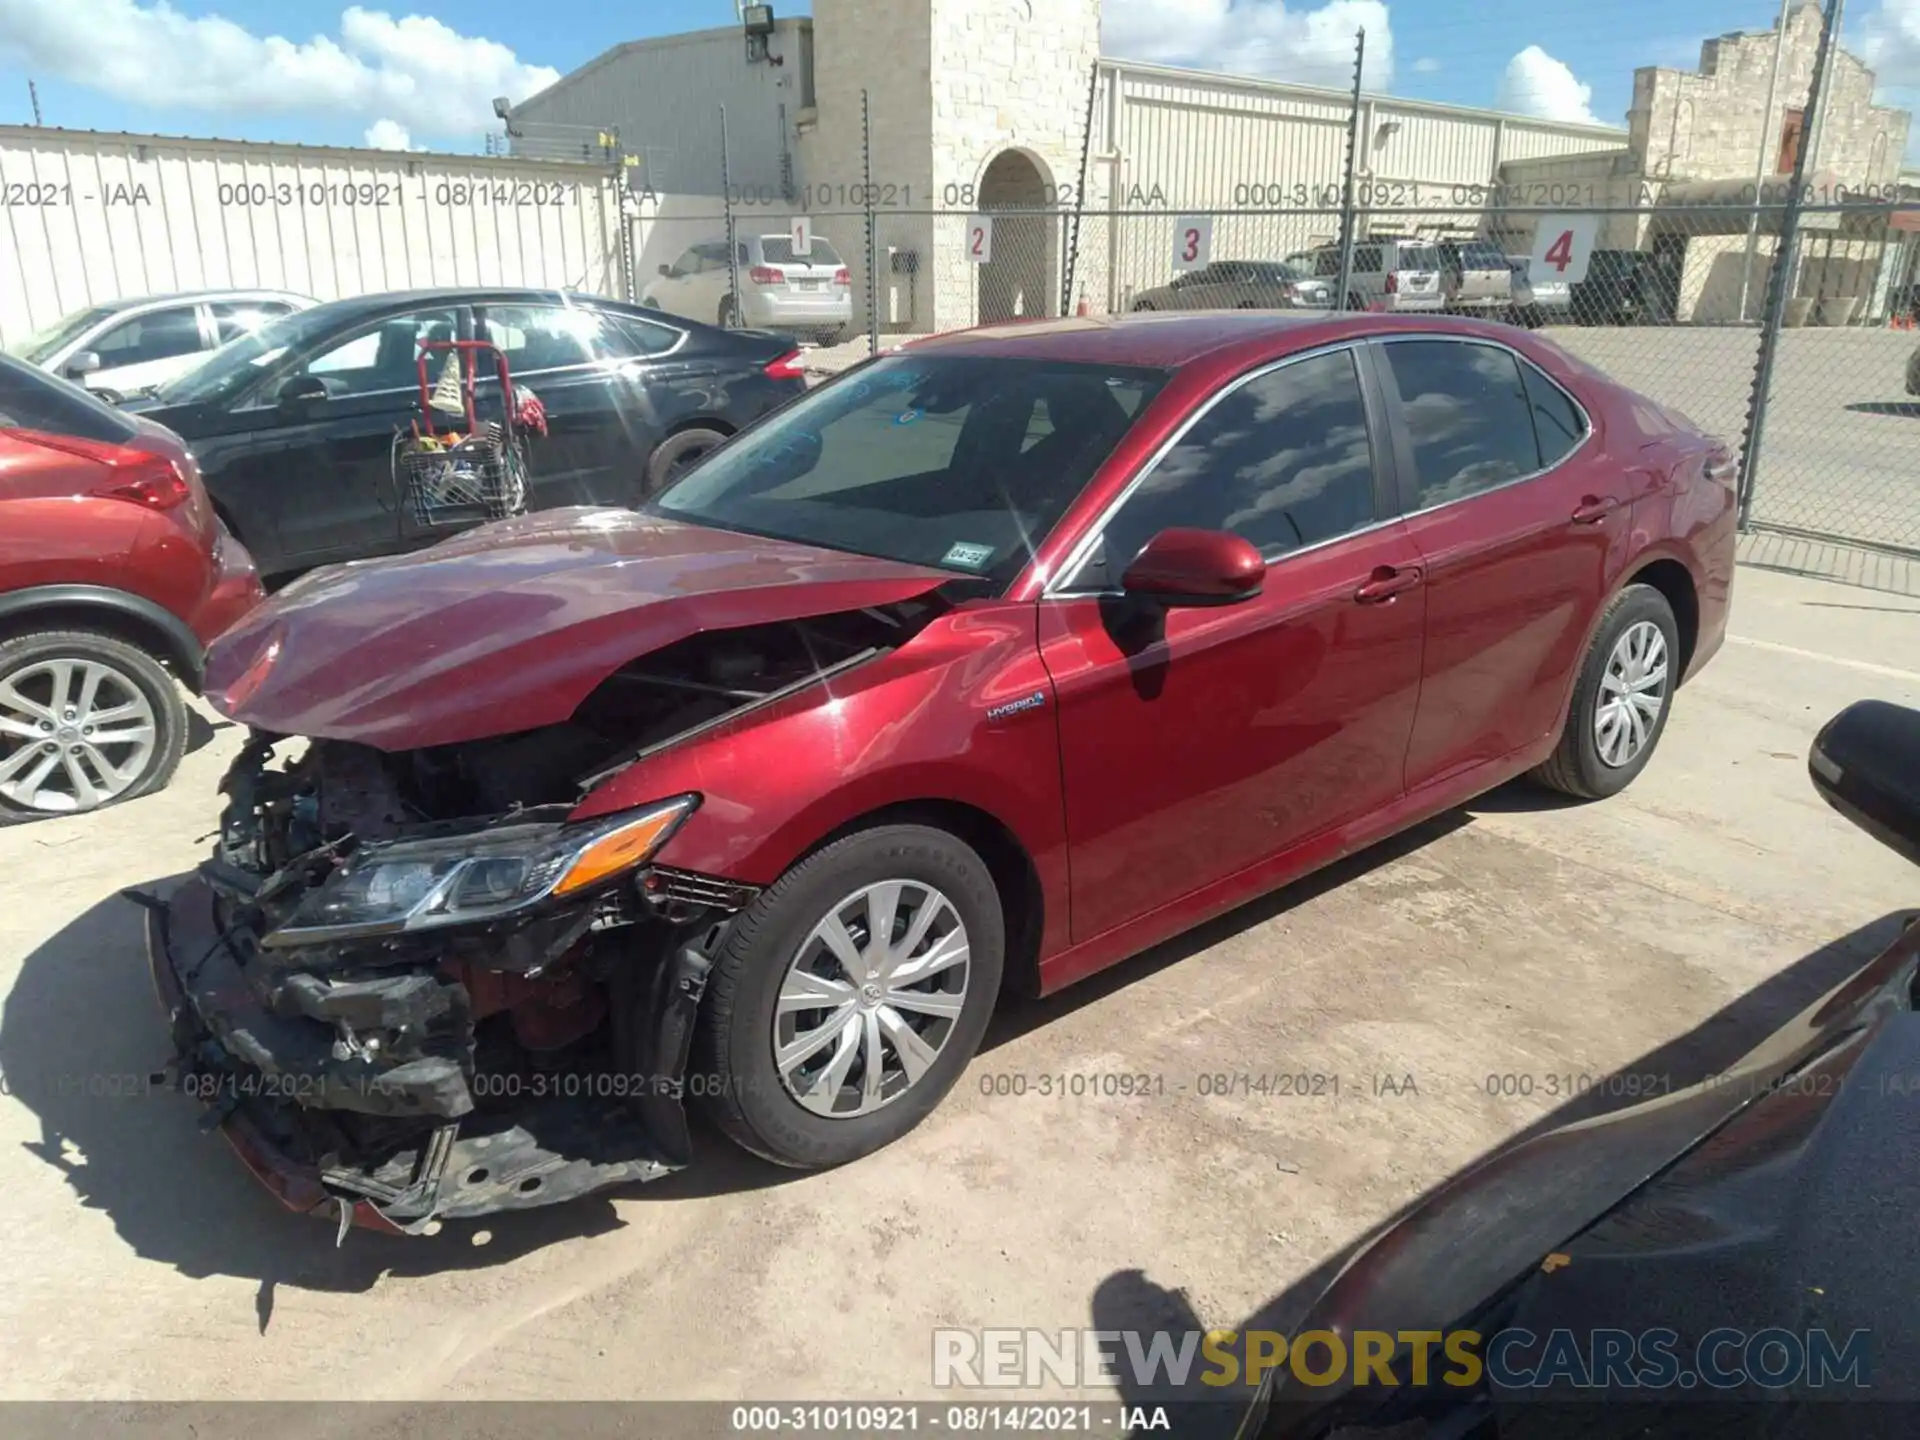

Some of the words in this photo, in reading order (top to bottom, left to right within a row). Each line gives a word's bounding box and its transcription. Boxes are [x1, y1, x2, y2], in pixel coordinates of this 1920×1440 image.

[796, 225, 803, 249] 1
[972, 227, 984, 255] 2
[1181, 228, 1200, 262] 3
[1544, 230, 1575, 272] 4
